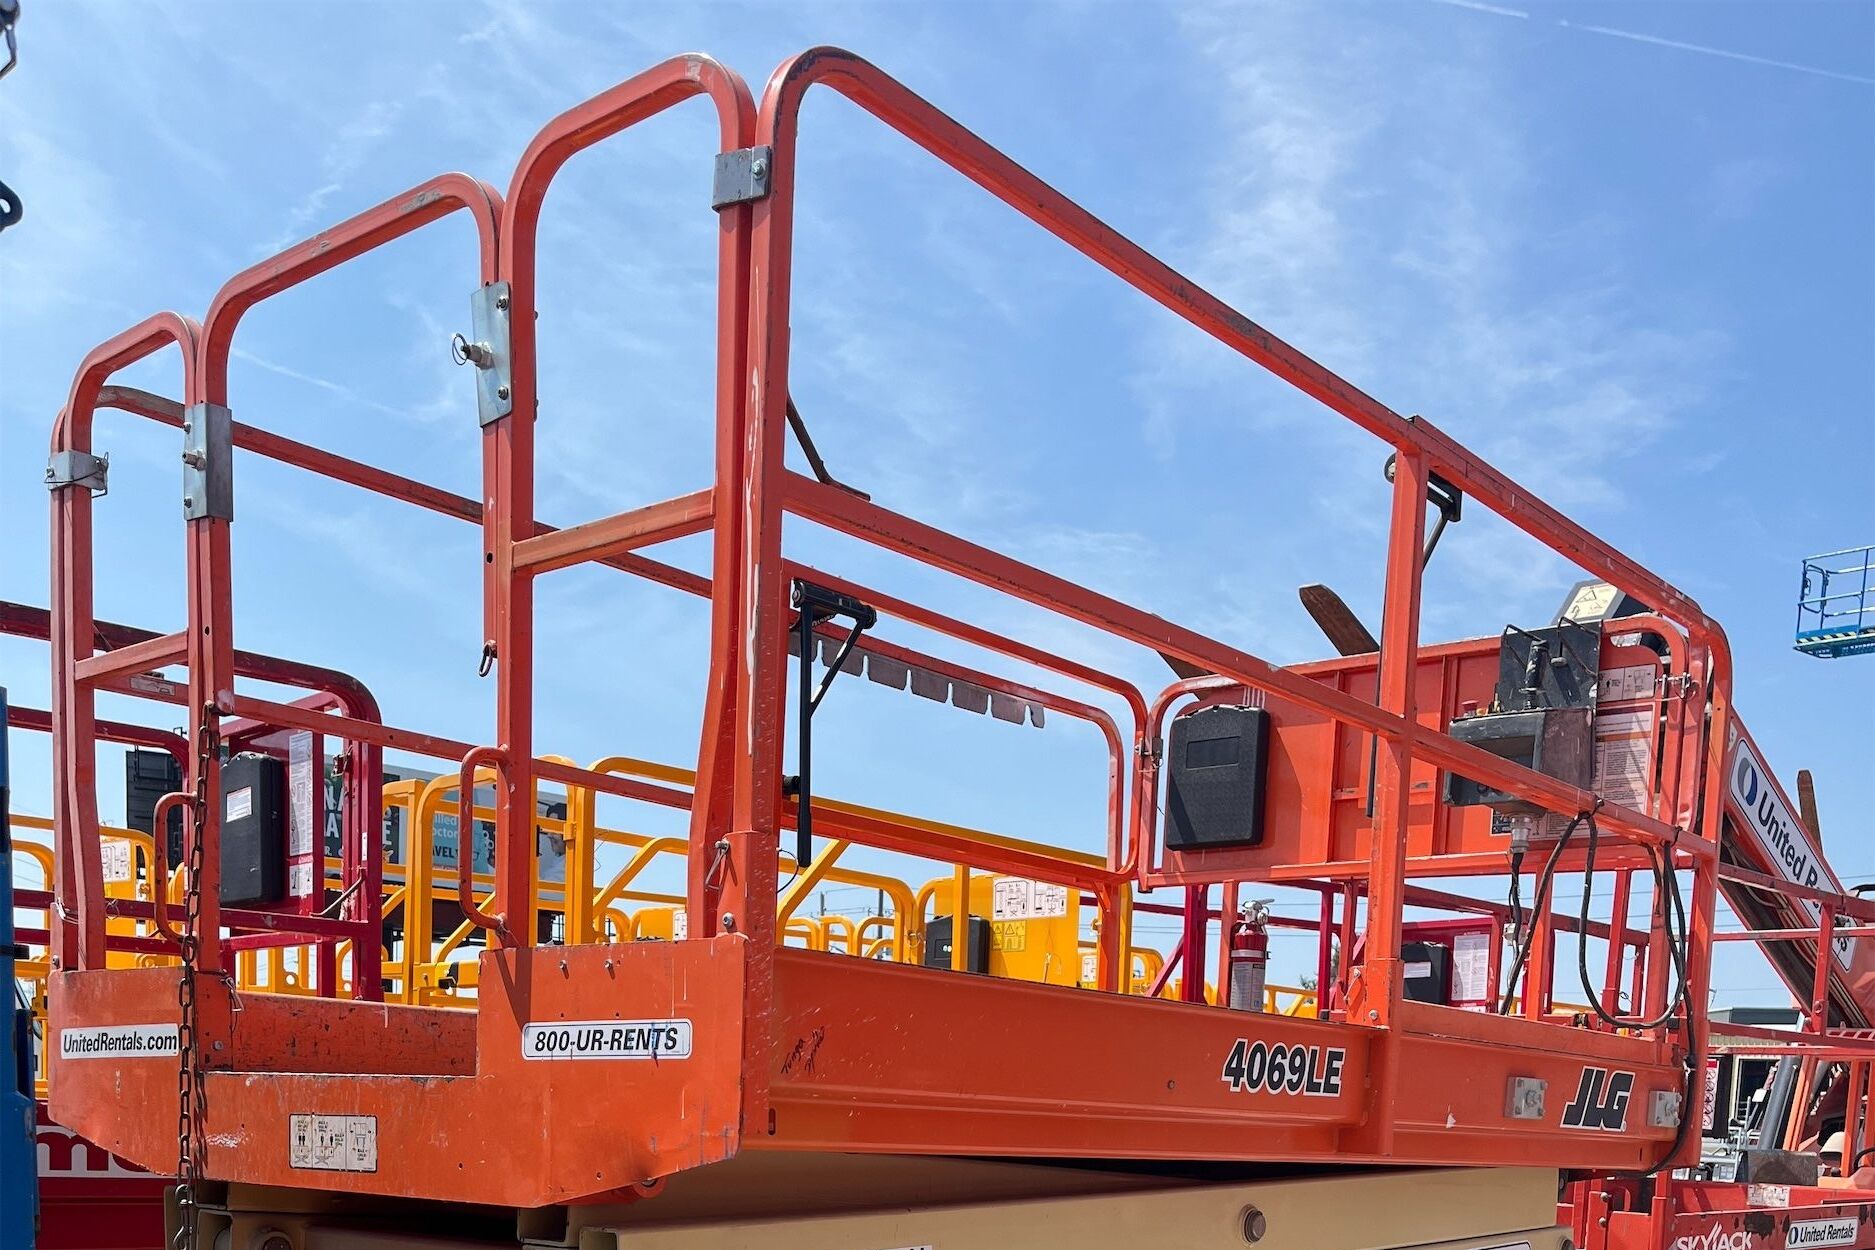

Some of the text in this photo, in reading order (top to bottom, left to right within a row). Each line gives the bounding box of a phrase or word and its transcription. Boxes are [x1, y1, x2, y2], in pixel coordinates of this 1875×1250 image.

[1758, 791, 1806, 882] United
[63, 1032, 177, 1053] UnitedRentals.com
[535, 1028, 678, 1052] 800-UR-RENTS
[1222, 1038, 1345, 1097] 4069LE
[1560, 1065, 1635, 1132] JLG
[1800, 1223, 1854, 1243] United Rentals
